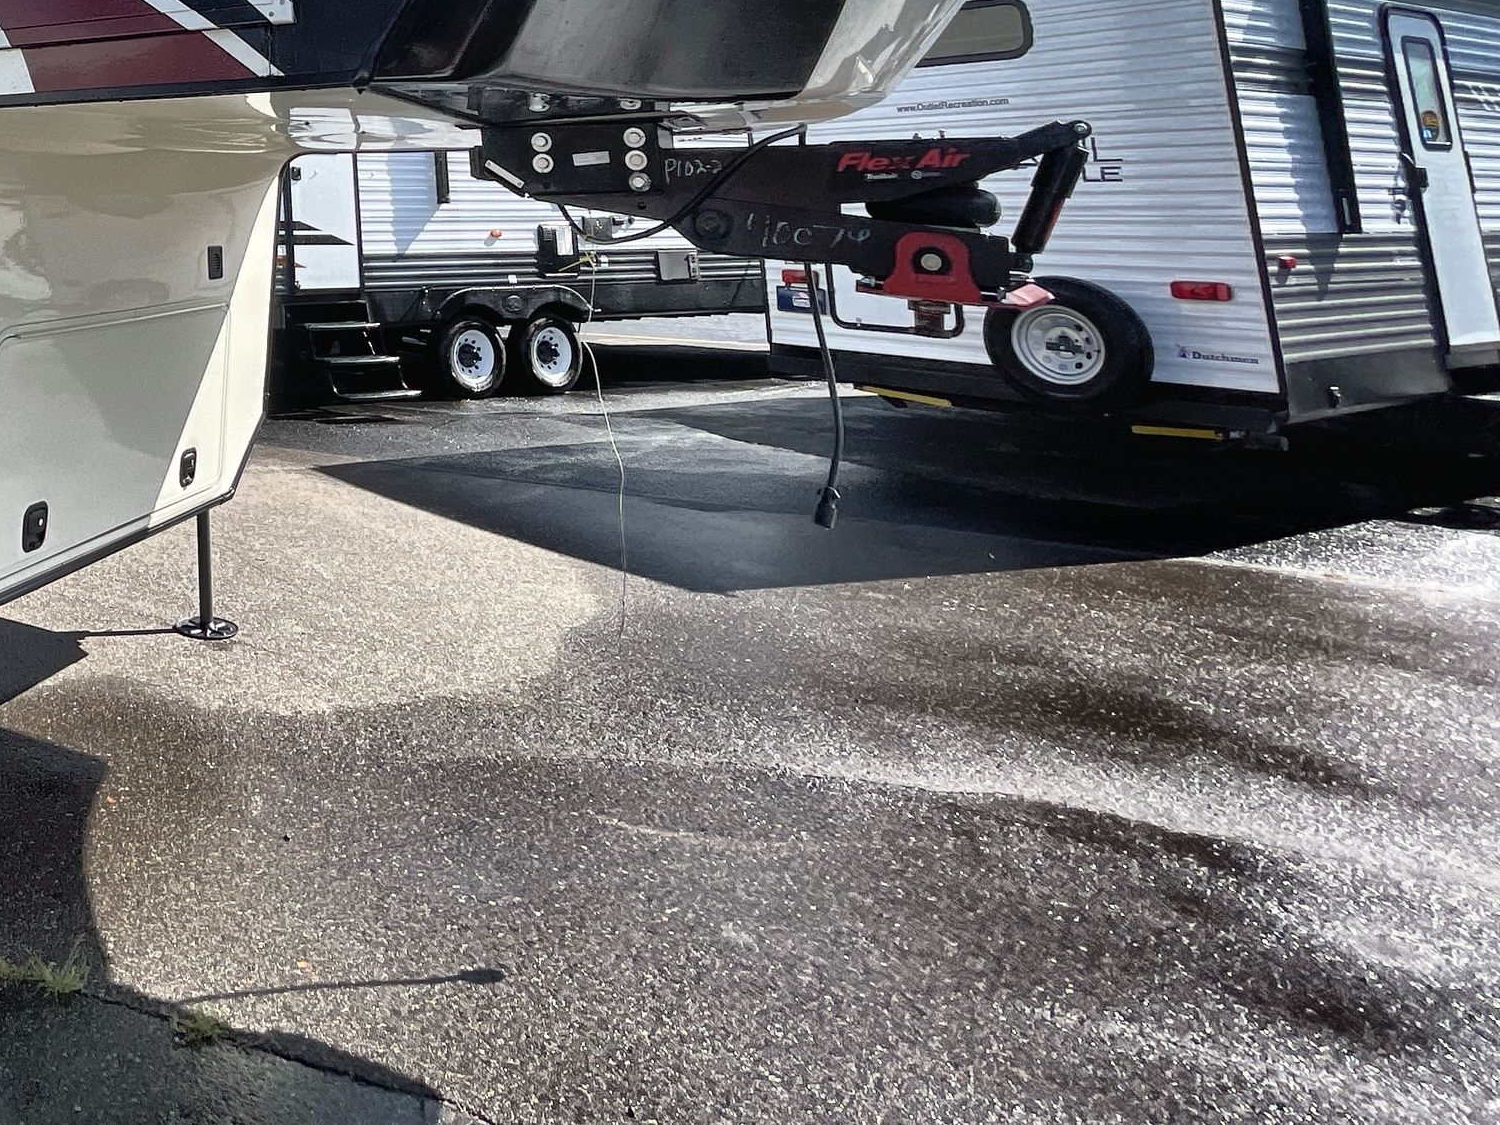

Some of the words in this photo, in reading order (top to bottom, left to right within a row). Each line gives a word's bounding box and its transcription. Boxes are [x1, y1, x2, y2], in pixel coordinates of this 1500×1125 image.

[896, 98, 1009, 113] www.OutletRecreation.com
[915, 145, 971, 169] Air
[1192, 351, 1259, 364] Dutchmen
